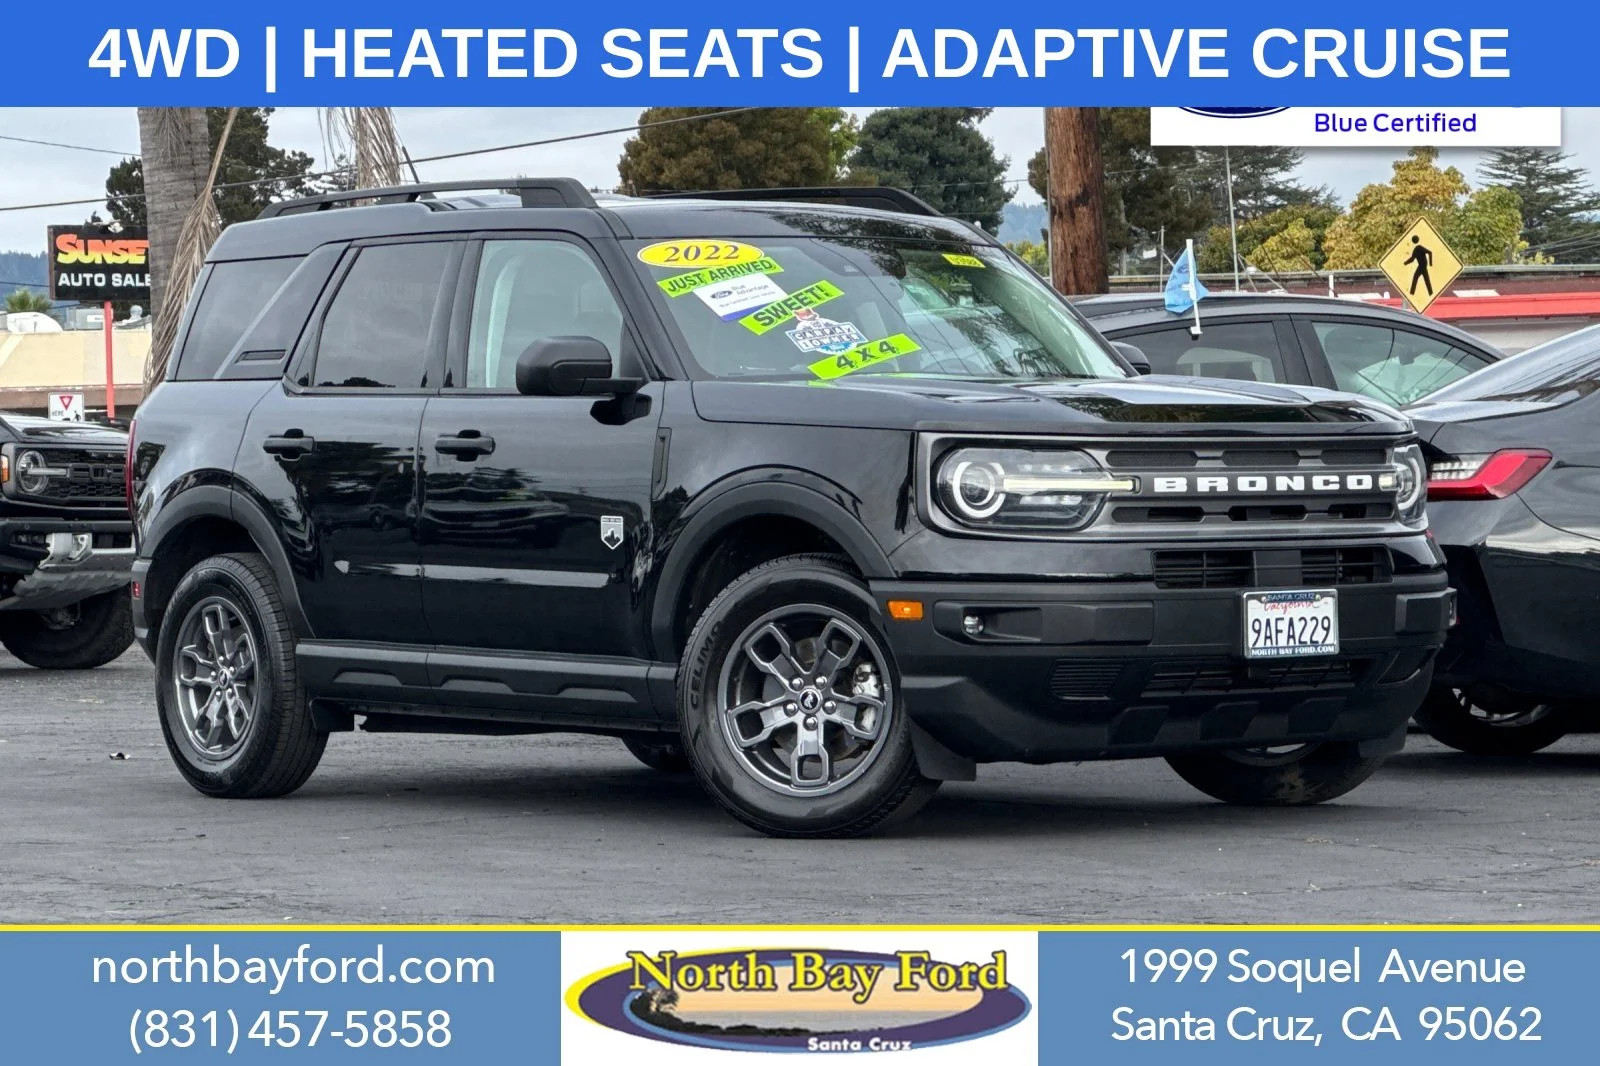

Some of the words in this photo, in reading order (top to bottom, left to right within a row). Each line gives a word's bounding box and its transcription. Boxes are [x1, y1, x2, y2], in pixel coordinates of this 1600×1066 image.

[56, 233, 150, 264] SUNSE
[664, 244, 740, 263] 2022
[58, 273, 106, 287] AUTO
[668, 274, 705, 293] JUST
[708, 259, 775, 281] ARRIVED
[753, 285, 832, 327] SWEET!
[1153, 474, 1373, 493] BRONCO
[1267, 594, 1293, 602] SANTA
[1294, 592, 1315, 600] CRUZ
[1251, 615, 1331, 648] 9AFA229
[1251, 648, 1277, 656] NORTH
[1279, 647, 1294, 655] BAY
